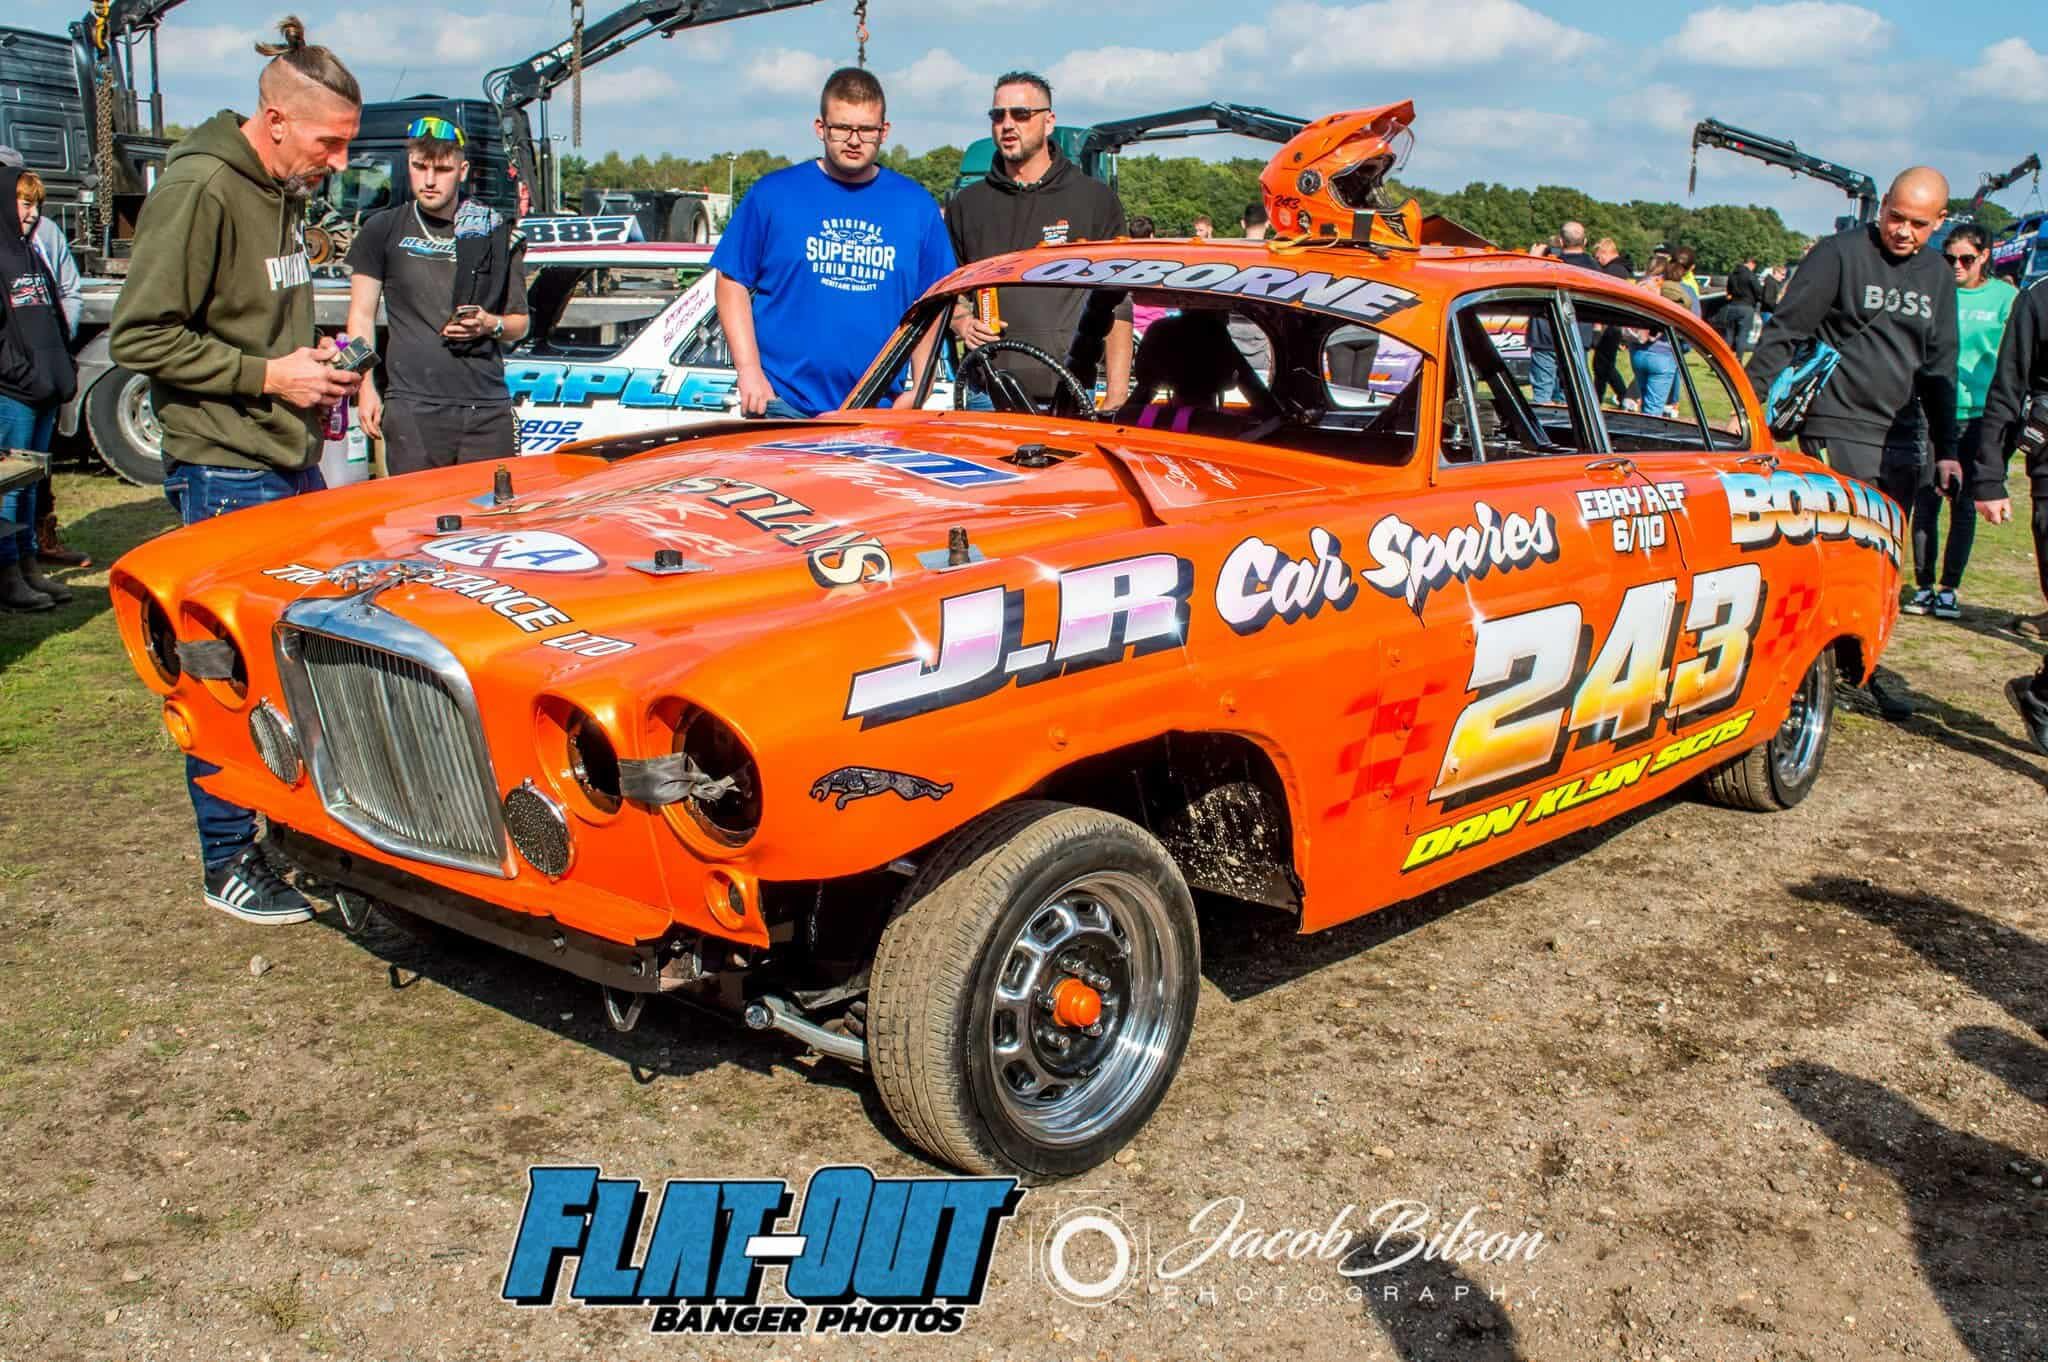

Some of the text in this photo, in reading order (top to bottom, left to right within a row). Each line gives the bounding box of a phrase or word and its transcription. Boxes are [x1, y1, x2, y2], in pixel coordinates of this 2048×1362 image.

[822, 218, 882, 237] ORIGINAL
[806, 235, 896, 272] SUPERIOR
[812, 261, 886, 281] DENIM BRAND
[1022, 258, 1424, 323] OSBORNE
[1863, 284, 1933, 319] BOSS
[1576, 481, 1687, 521] EBAY REF
[1215, 501, 1561, 636] Car Spares
[540, 630, 638, 658] LTD
[1429, 562, 1764, 803] 243
[1400, 709, 1756, 875] DAN KLYN SIGNS
